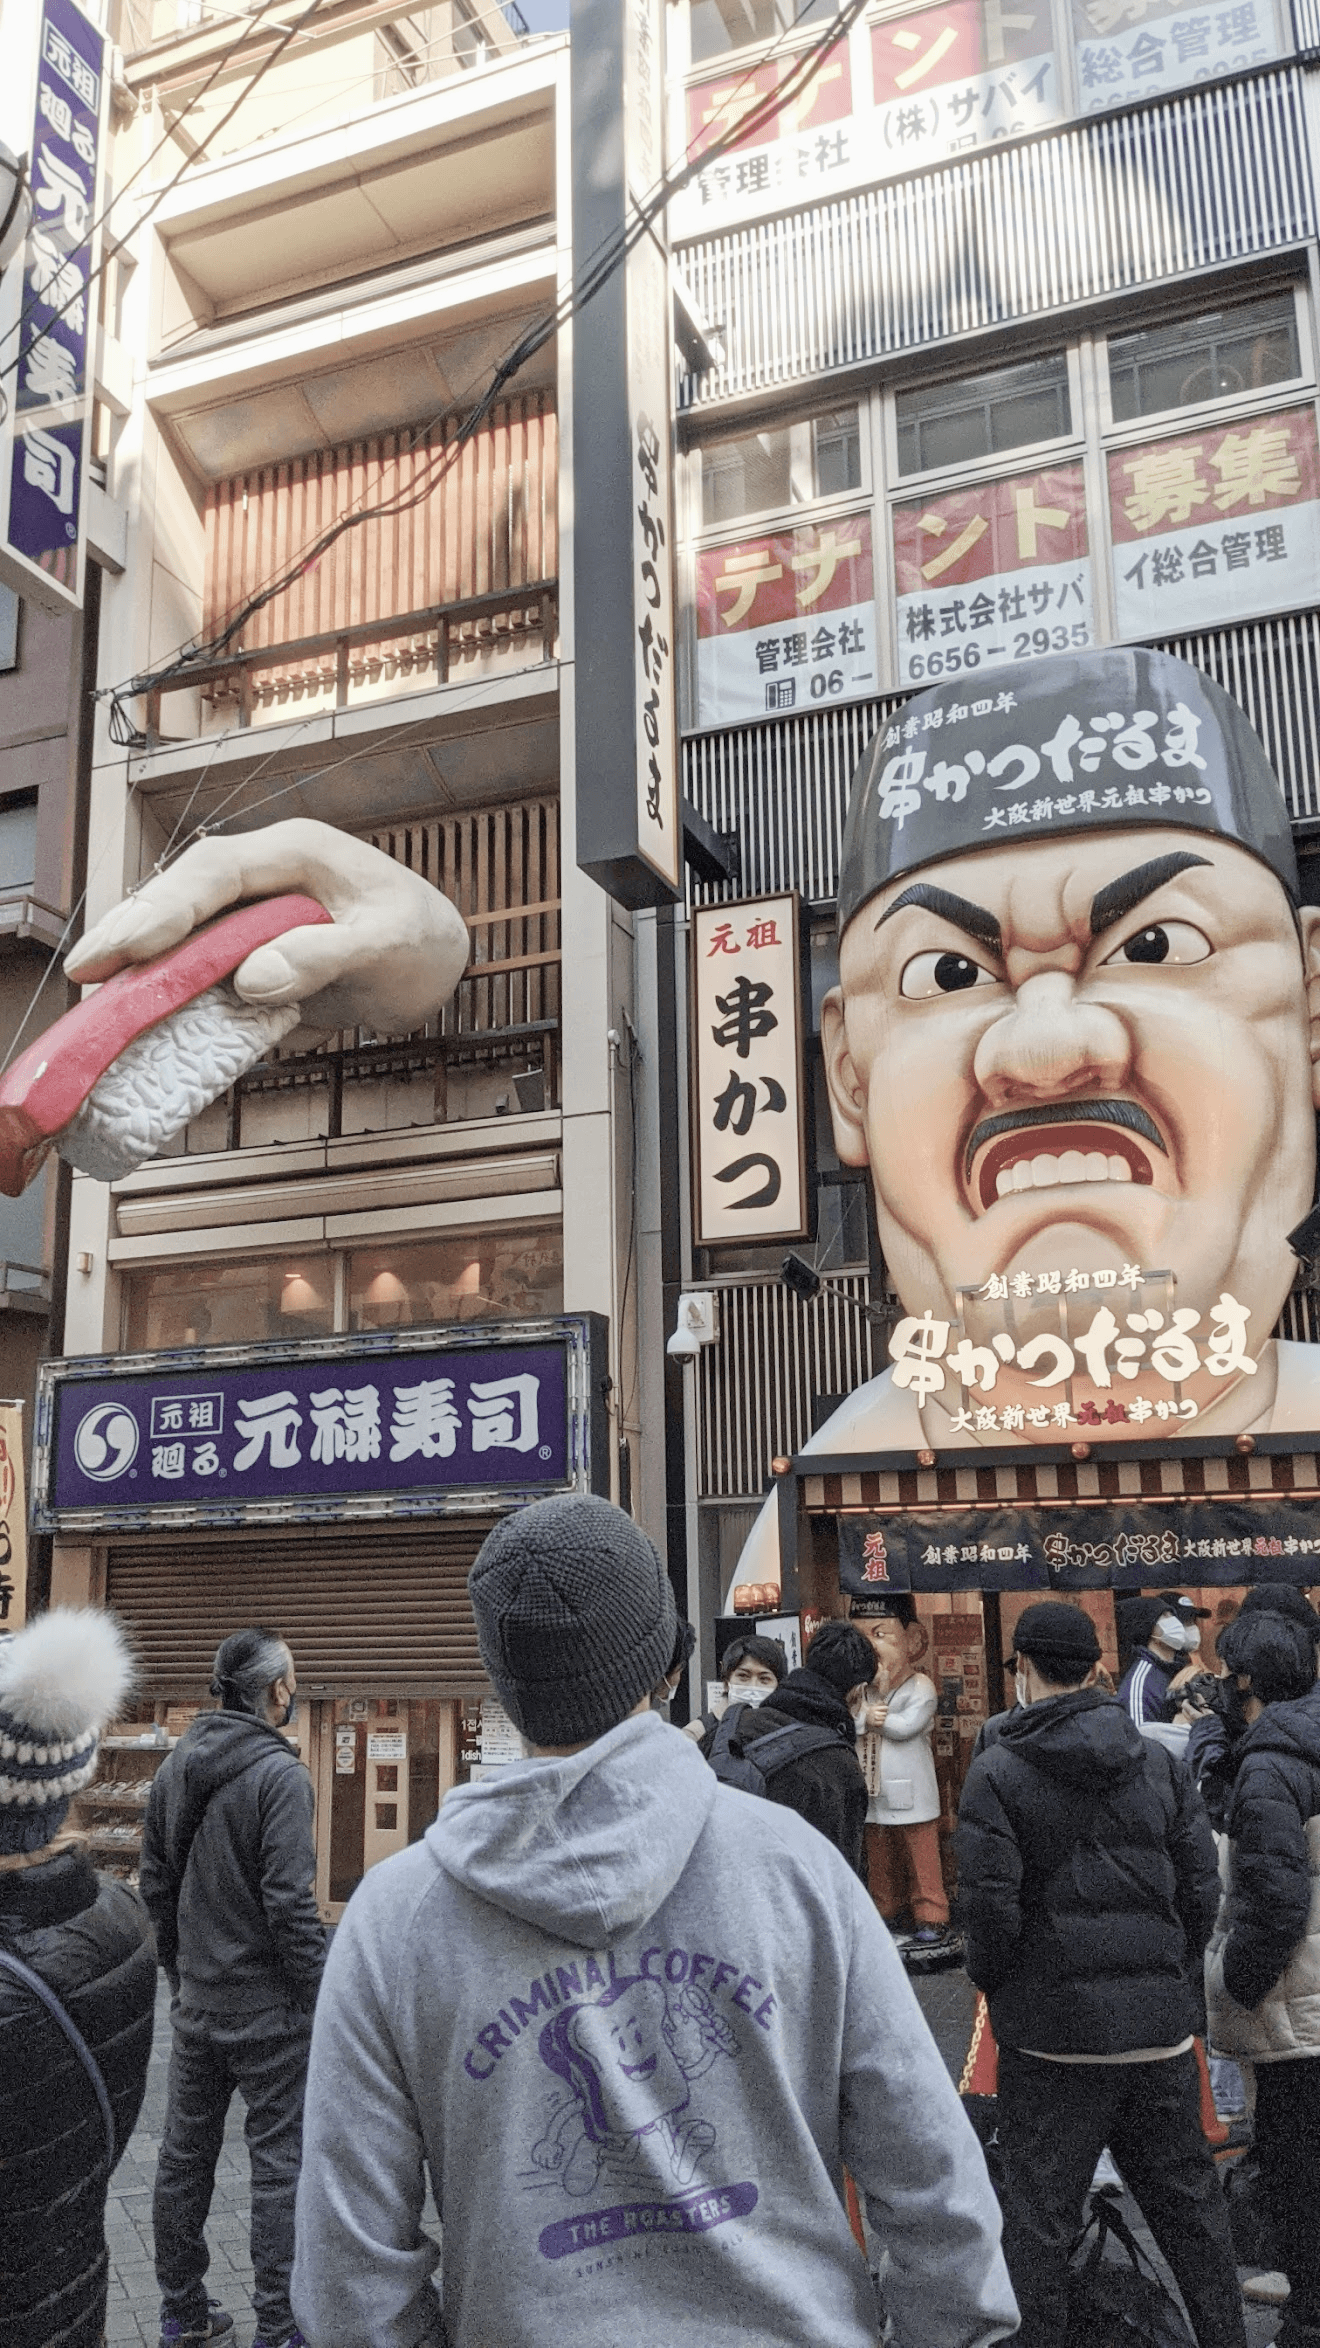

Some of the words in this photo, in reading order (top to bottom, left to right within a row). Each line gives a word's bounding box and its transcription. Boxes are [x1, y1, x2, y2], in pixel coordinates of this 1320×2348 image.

[48, 31, 96, 108] 元祖
[1081, 2, 1261, 88] 総合管理
[40, 81, 96, 166] 廻る
[23, 142, 89, 515] 元禄寿司
[715, 531, 861, 627] テナ
[916, 487, 1071, 581] ント
[1122, 428, 1302, 532] 募集
[638, 410, 668, 830] 串かつだるま
[755, 618, 866, 675] 管理会社
[906, 573, 1085, 643] 株式会社サバ
[1124, 524, 1288, 590] イ総合管理
[881, 692, 1017, 752] 創業昭和四年
[878, 702, 1208, 830] 串かつだるま
[981, 782, 1211, 830] 大阪新世界元祖串かつ
[706, 918, 783, 958] 元祖
[711, 975, 787, 1210] 串かつ
[978, 1263, 1145, 1300] 創業昭和四年
[888, 1293, 1258, 1409] 串かつだるま
[160, 1400, 213, 1430] 元祖
[233, 1372, 541, 1471] 元禄寿司
[949, 1396, 1199, 1433] 大阪新世界元祖串かつ
[151, 1441, 220, 1479] 廻る
[861, 1531, 890, 1582] 元祖
[920, 1543, 1033, 1566] 創業昭和四年
[1043, 1530, 1181, 1573] 串かつだるま
[464, 1949, 618, 2080] CRIMINAL
[639, 1947, 778, 2031] COFFEE
[570, 2216, 611, 2244] THE
